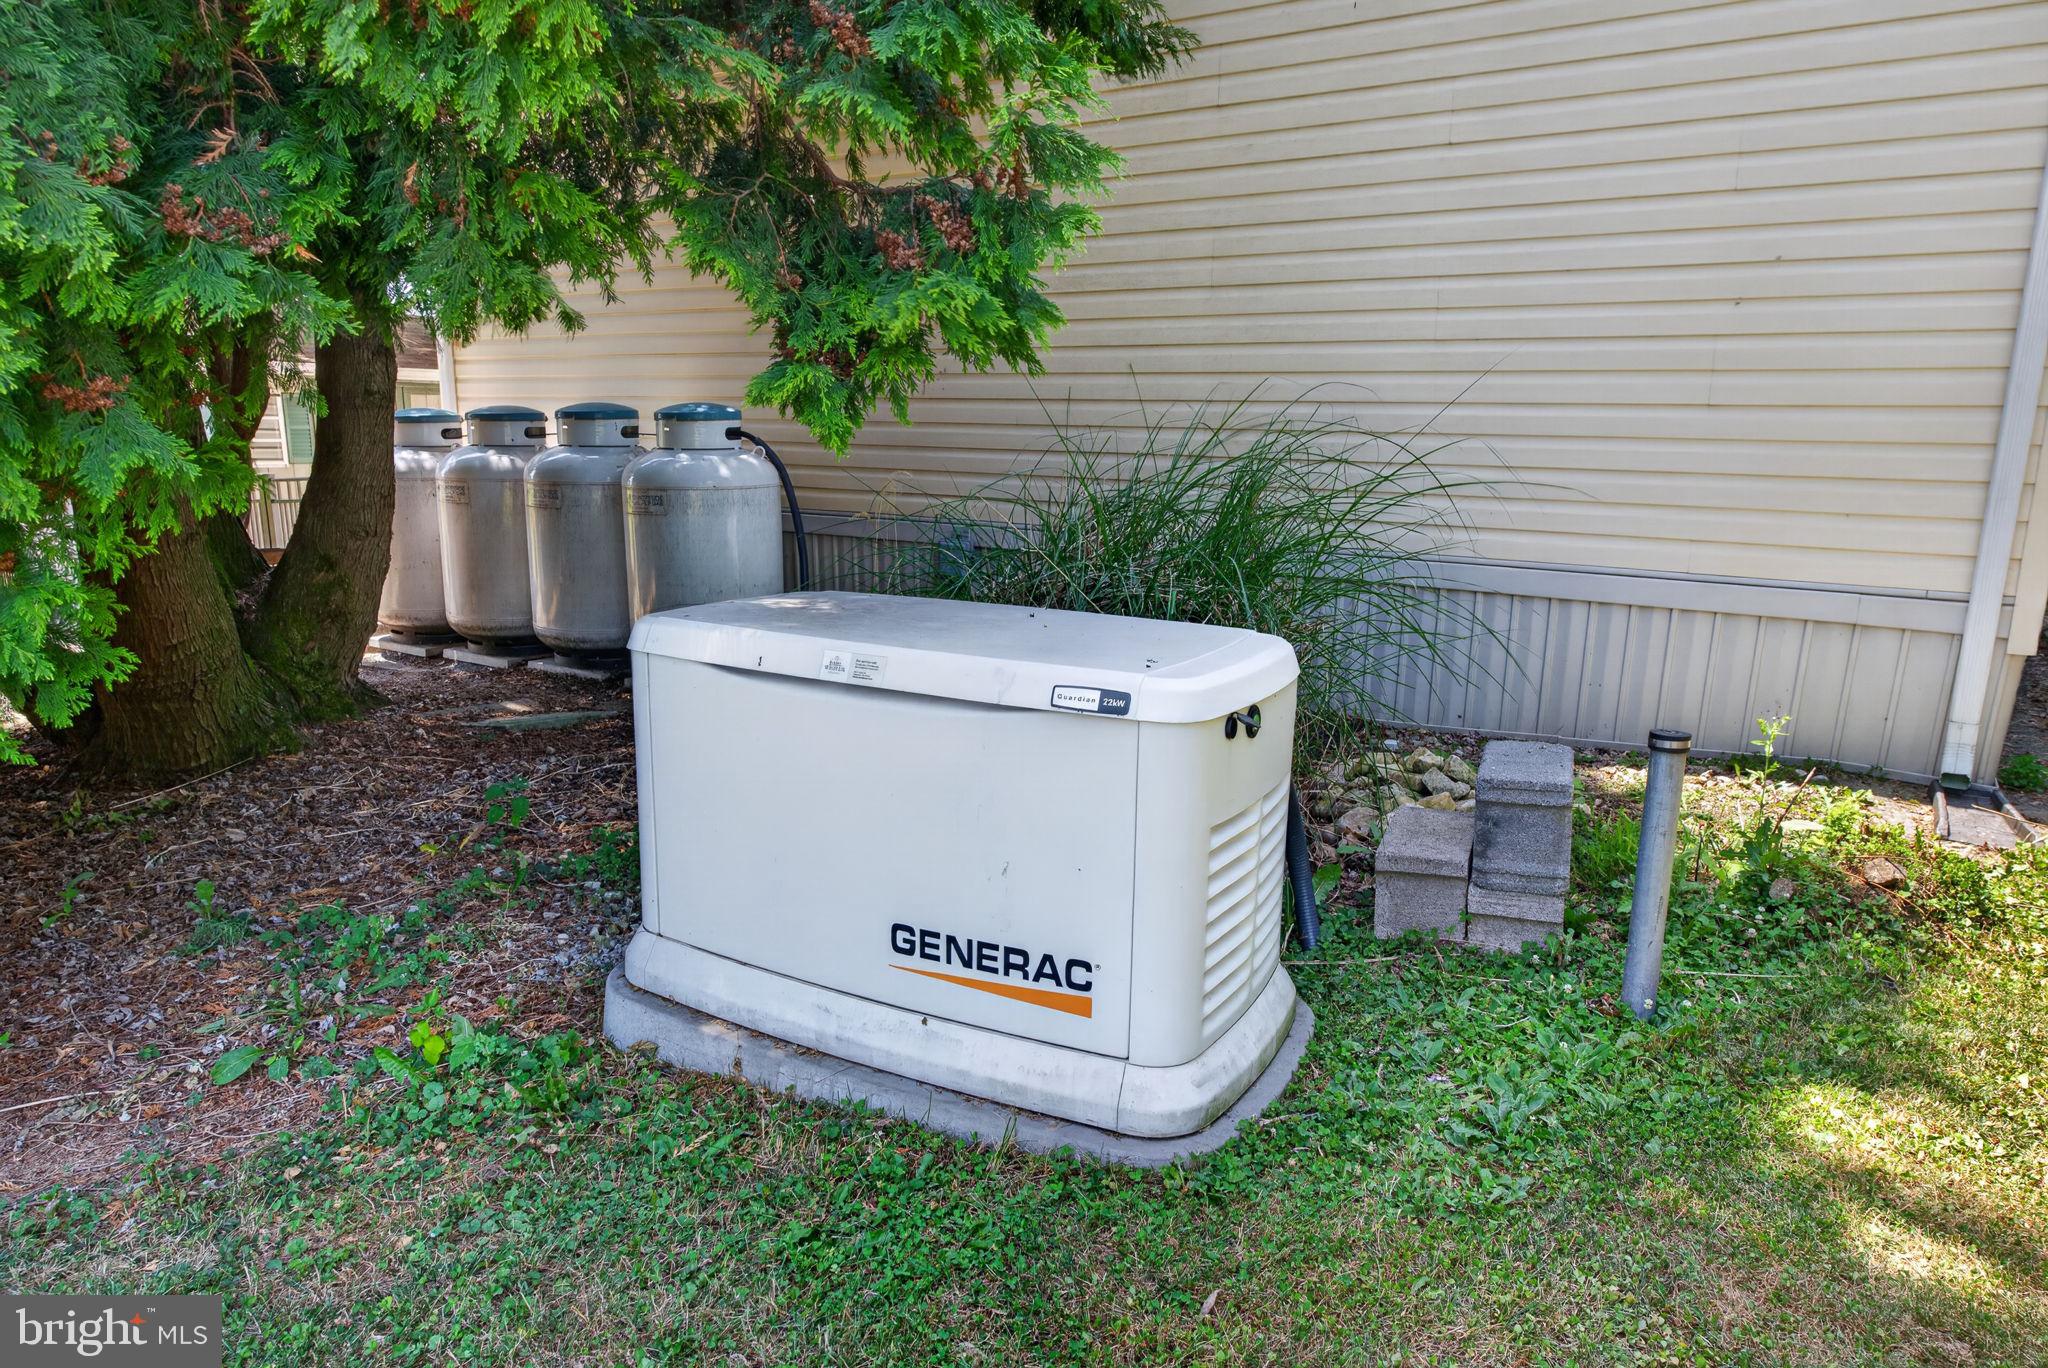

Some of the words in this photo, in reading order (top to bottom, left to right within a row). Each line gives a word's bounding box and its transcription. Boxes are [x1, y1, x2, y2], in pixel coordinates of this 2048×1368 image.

[1057, 693, 1096, 703] Guardian
[1102, 698, 1126, 707] 22kW
[891, 923, 1093, 992] GENERAC
